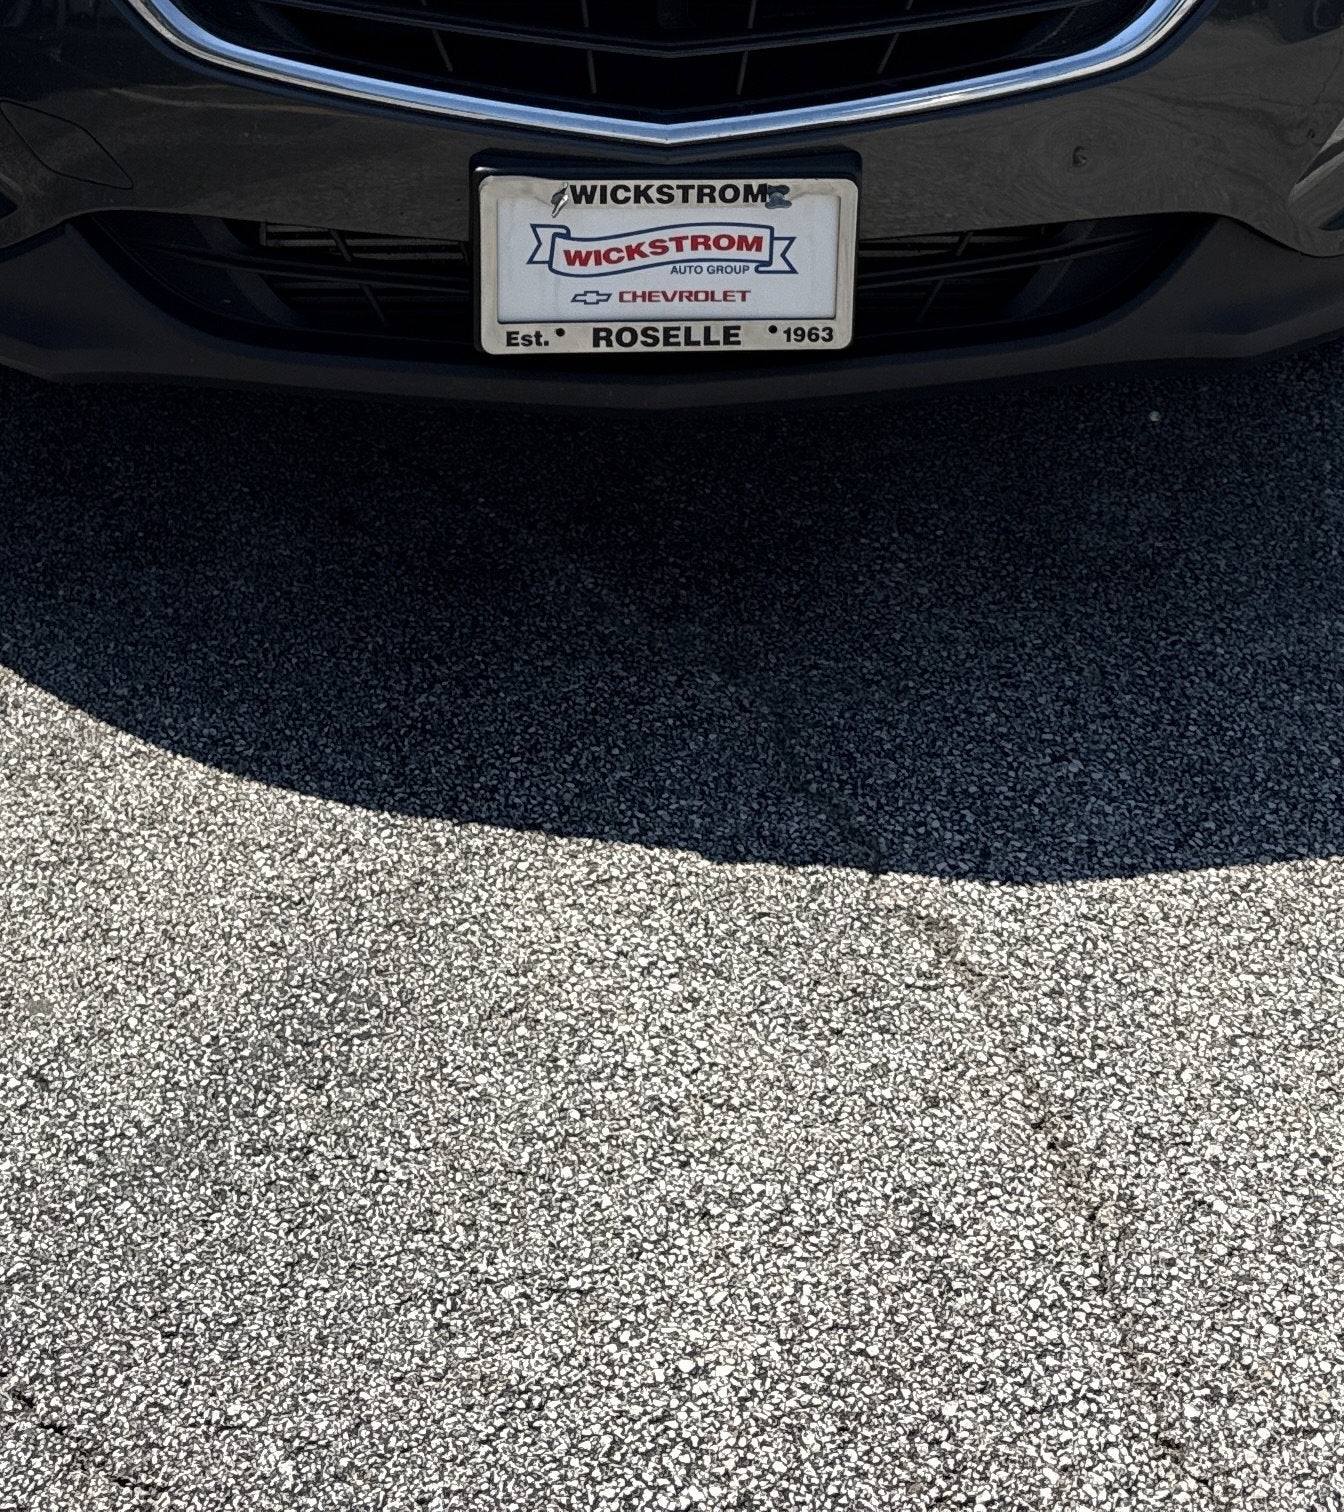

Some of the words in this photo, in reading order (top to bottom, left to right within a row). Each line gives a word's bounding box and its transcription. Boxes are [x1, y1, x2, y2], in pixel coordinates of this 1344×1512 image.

[569, 183, 768, 205] WICKSTROM
[563, 233, 764, 267] WICKSTROM
[670, 264, 704, 275] AUTO
[706, 264, 750, 275] GROUP
[618, 289, 752, 304] CHEVROLET
[505, 330, 550, 348] Est.
[591, 325, 742, 348] ROSELLE
[783, 326, 834, 343] 1963
